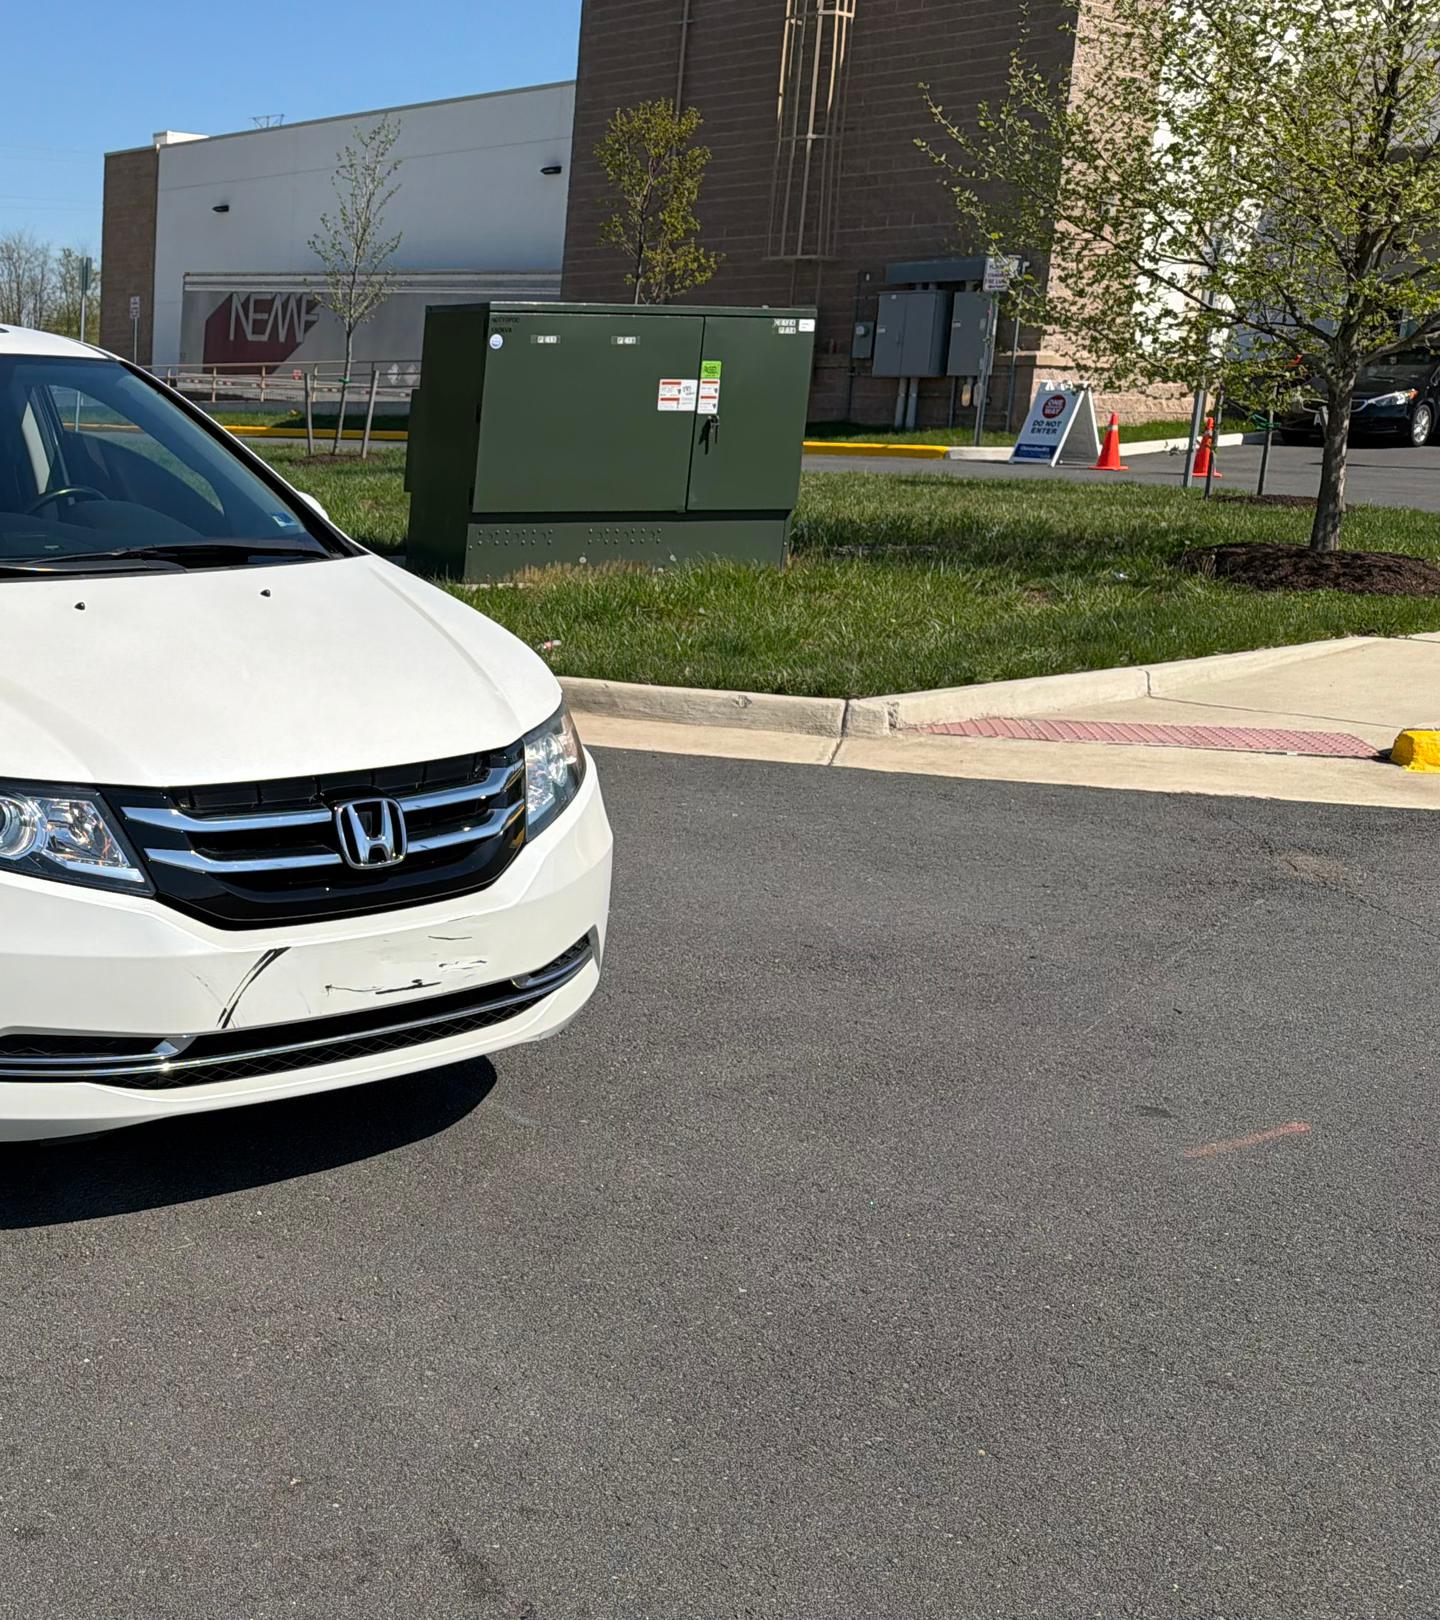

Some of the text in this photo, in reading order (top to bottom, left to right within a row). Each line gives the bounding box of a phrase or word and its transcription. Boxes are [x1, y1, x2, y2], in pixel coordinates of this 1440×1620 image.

[1047, 399, 1064, 407] ONE
[1044, 407, 1061, 415] WAY
[1032, 420, 1062, 428] DO NOT
[1031, 427, 1057, 435] ENTER
